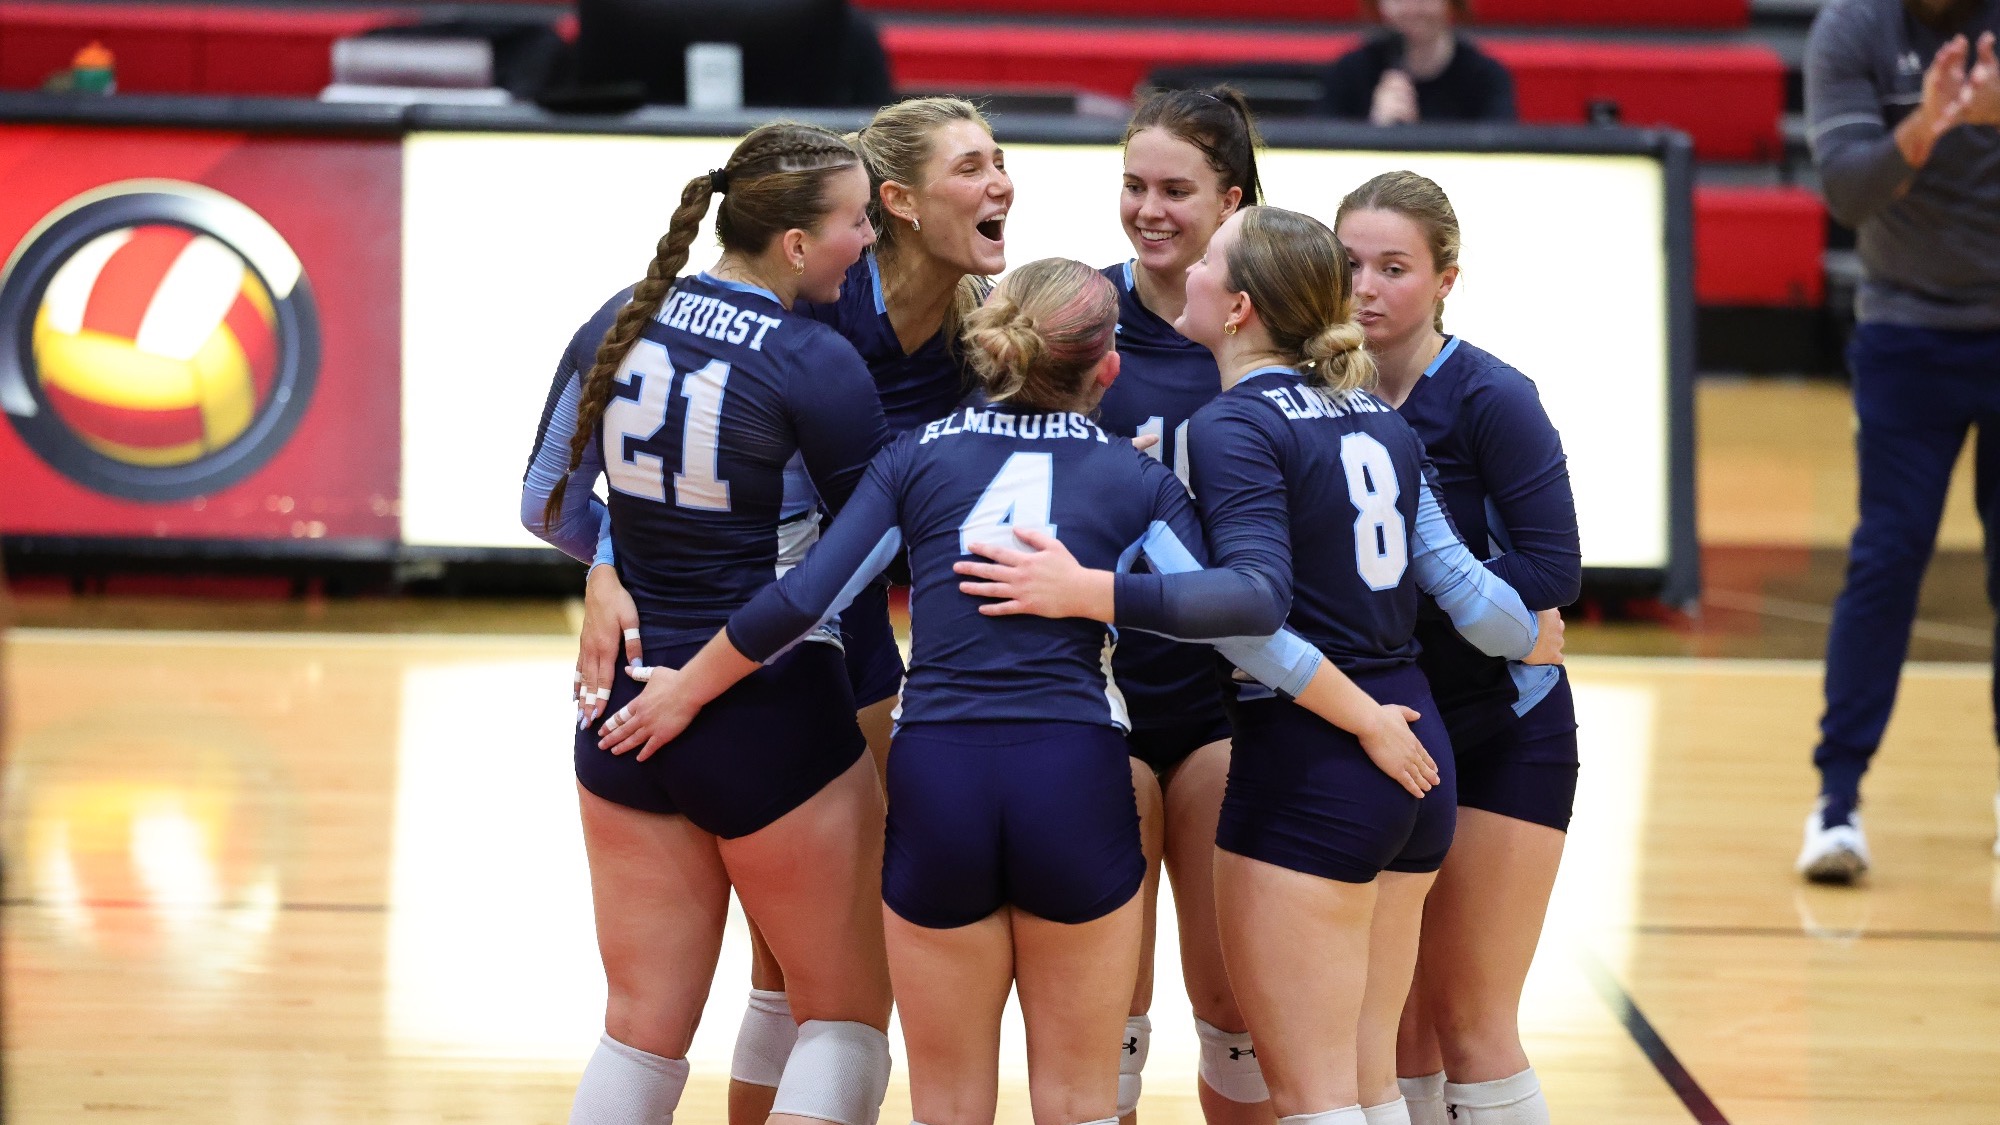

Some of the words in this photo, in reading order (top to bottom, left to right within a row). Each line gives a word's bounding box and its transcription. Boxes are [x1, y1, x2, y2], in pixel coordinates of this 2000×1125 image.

[654, 286, 782, 351] MHURST
[602, 337, 732, 511] 21
[959, 451, 1057, 555] 4
[1340, 431, 1409, 592] 8
